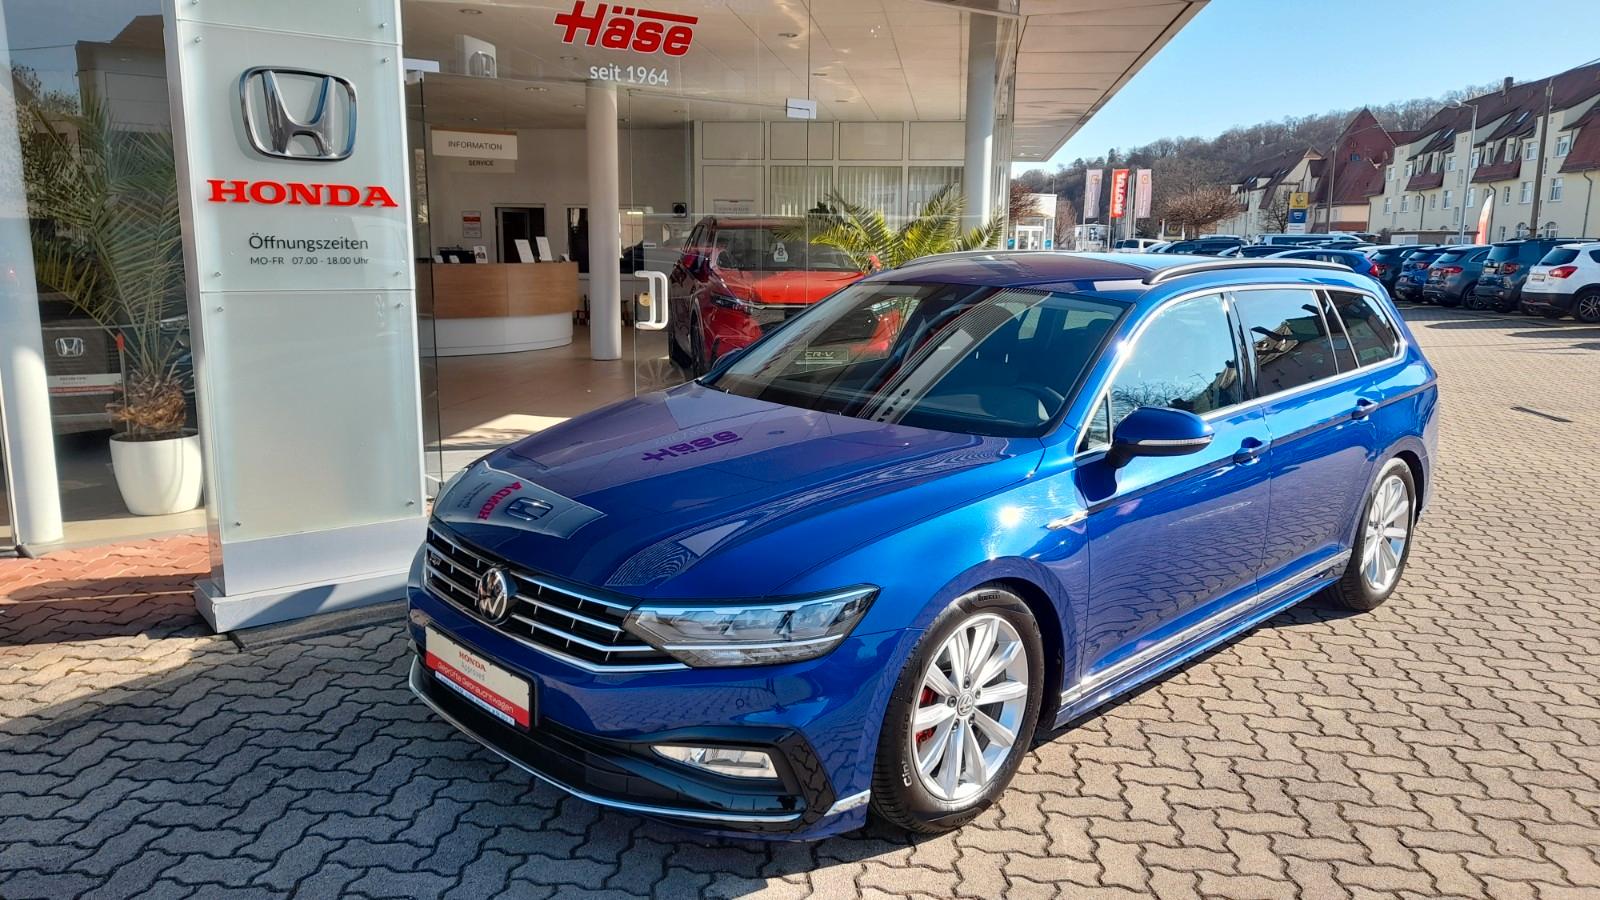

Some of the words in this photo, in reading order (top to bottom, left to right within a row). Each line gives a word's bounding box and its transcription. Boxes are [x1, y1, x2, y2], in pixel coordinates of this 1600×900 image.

[553, 0, 699, 57] Häse
[590, 63, 621, 82] seit
[626, 65, 669, 86] 1964
[448, 140, 503, 151] INFORMATION
[468, 159, 494, 167] SERVICE
[207, 179, 399, 207] HONDA
[249, 232, 369, 252] Öffnungszeiten
[250, 256, 285, 265] MO-FR
[292, 256, 318, 265] 07.00
[327, 256, 351, 265] 18.00
[353, 256, 369, 265] Uhr
[459, 651, 486, 672] HONDA
